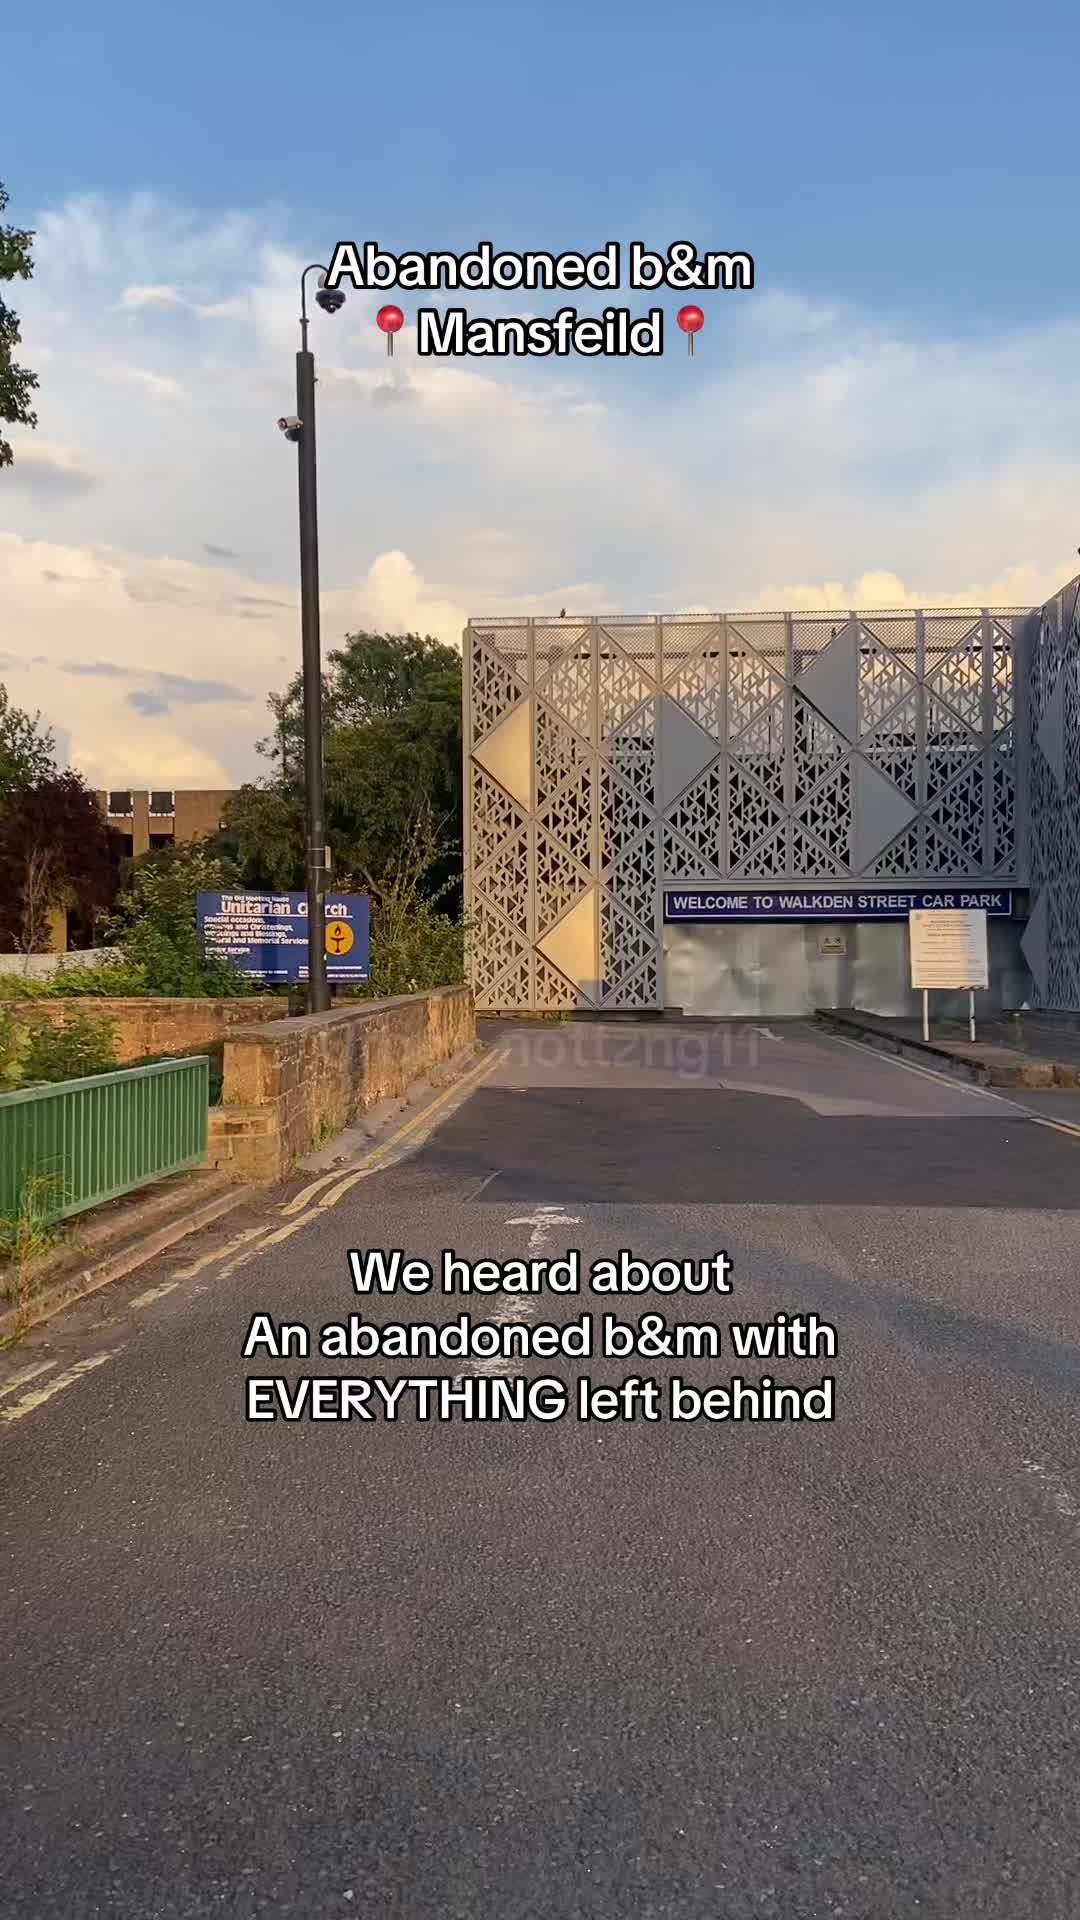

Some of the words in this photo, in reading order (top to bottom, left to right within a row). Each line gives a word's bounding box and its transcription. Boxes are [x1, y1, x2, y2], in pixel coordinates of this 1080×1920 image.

[221, 900, 291, 914] Unitarian
[297, 902, 348, 916] Crch
[673, 896, 748, 909] WELCOME
[753, 896, 773, 909] TO
[779, 895, 853, 908] WALKDEN
[857, 895, 917, 908] STREET
[922, 894, 955, 907] CAR
[960, 894, 1002, 907] PARK
